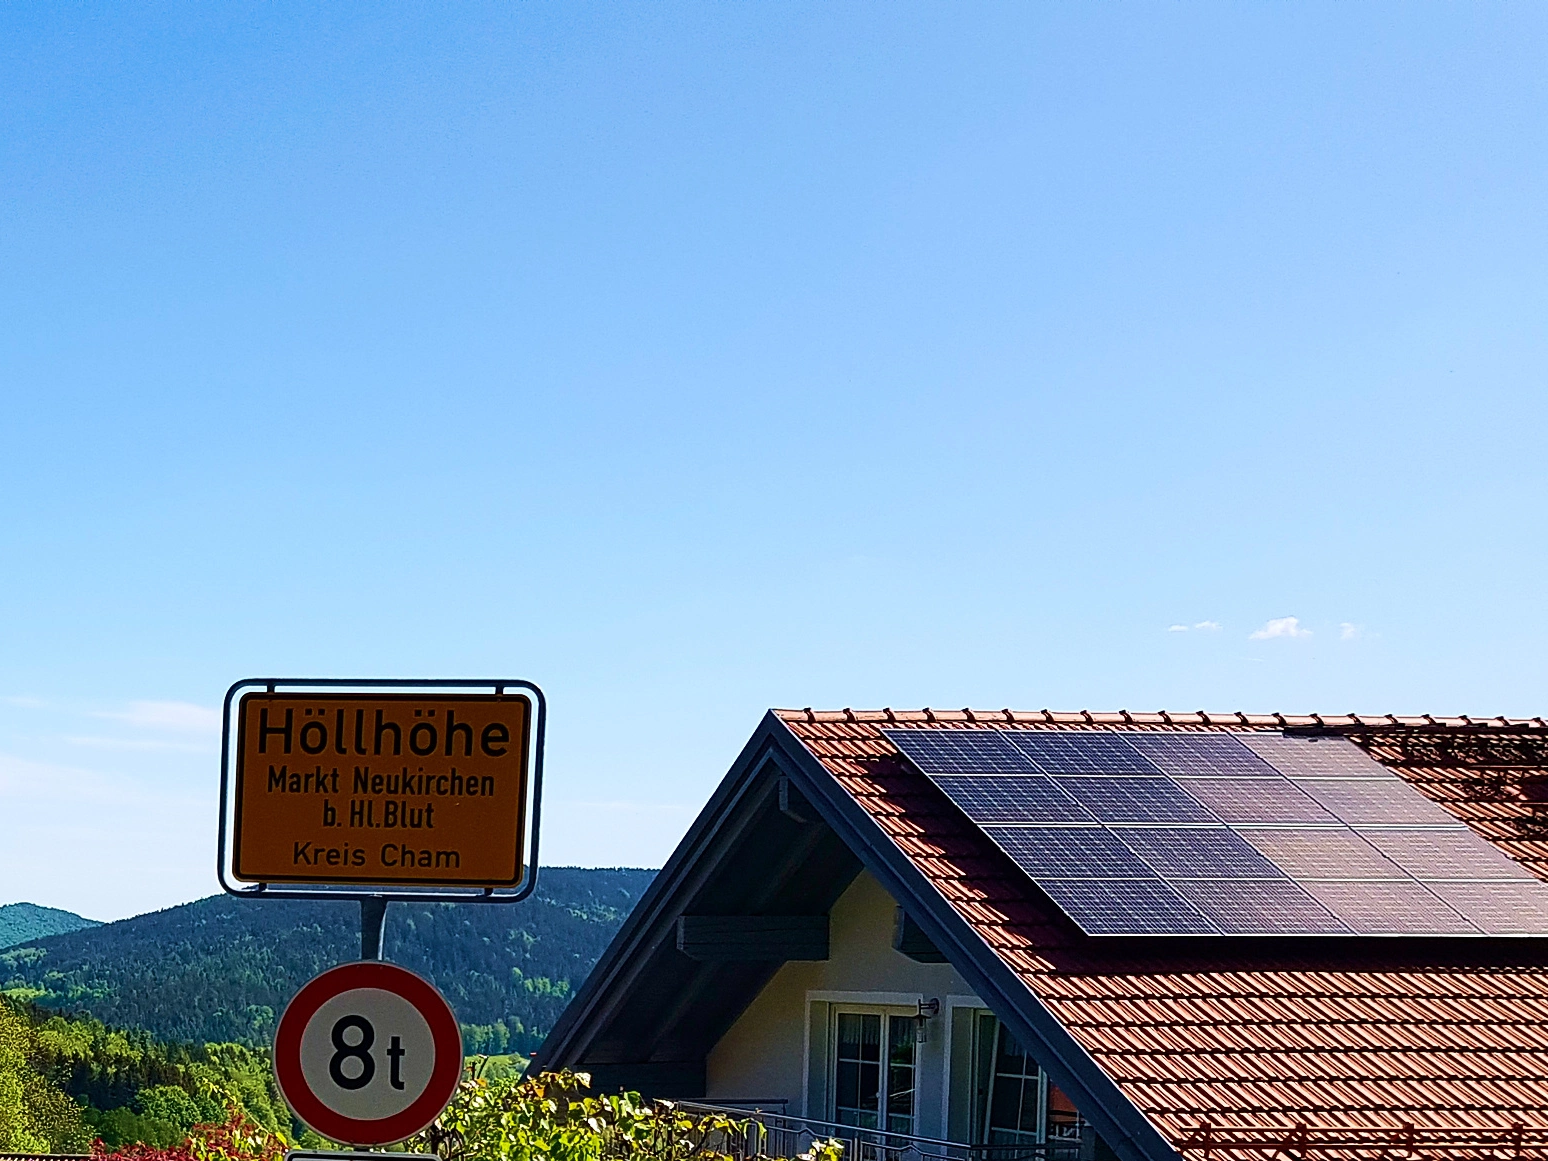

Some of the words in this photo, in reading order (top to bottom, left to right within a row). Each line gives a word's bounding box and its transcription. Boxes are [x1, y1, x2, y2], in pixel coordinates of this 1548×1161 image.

[258, 707, 510, 757] Höllhöhe
[267, 765, 340, 794] Markt
[353, 766, 495, 797] Neukirchen
[323, 799, 342, 828] b.
[293, 841, 366, 867] Kreis
[380, 843, 460, 868] Cham
